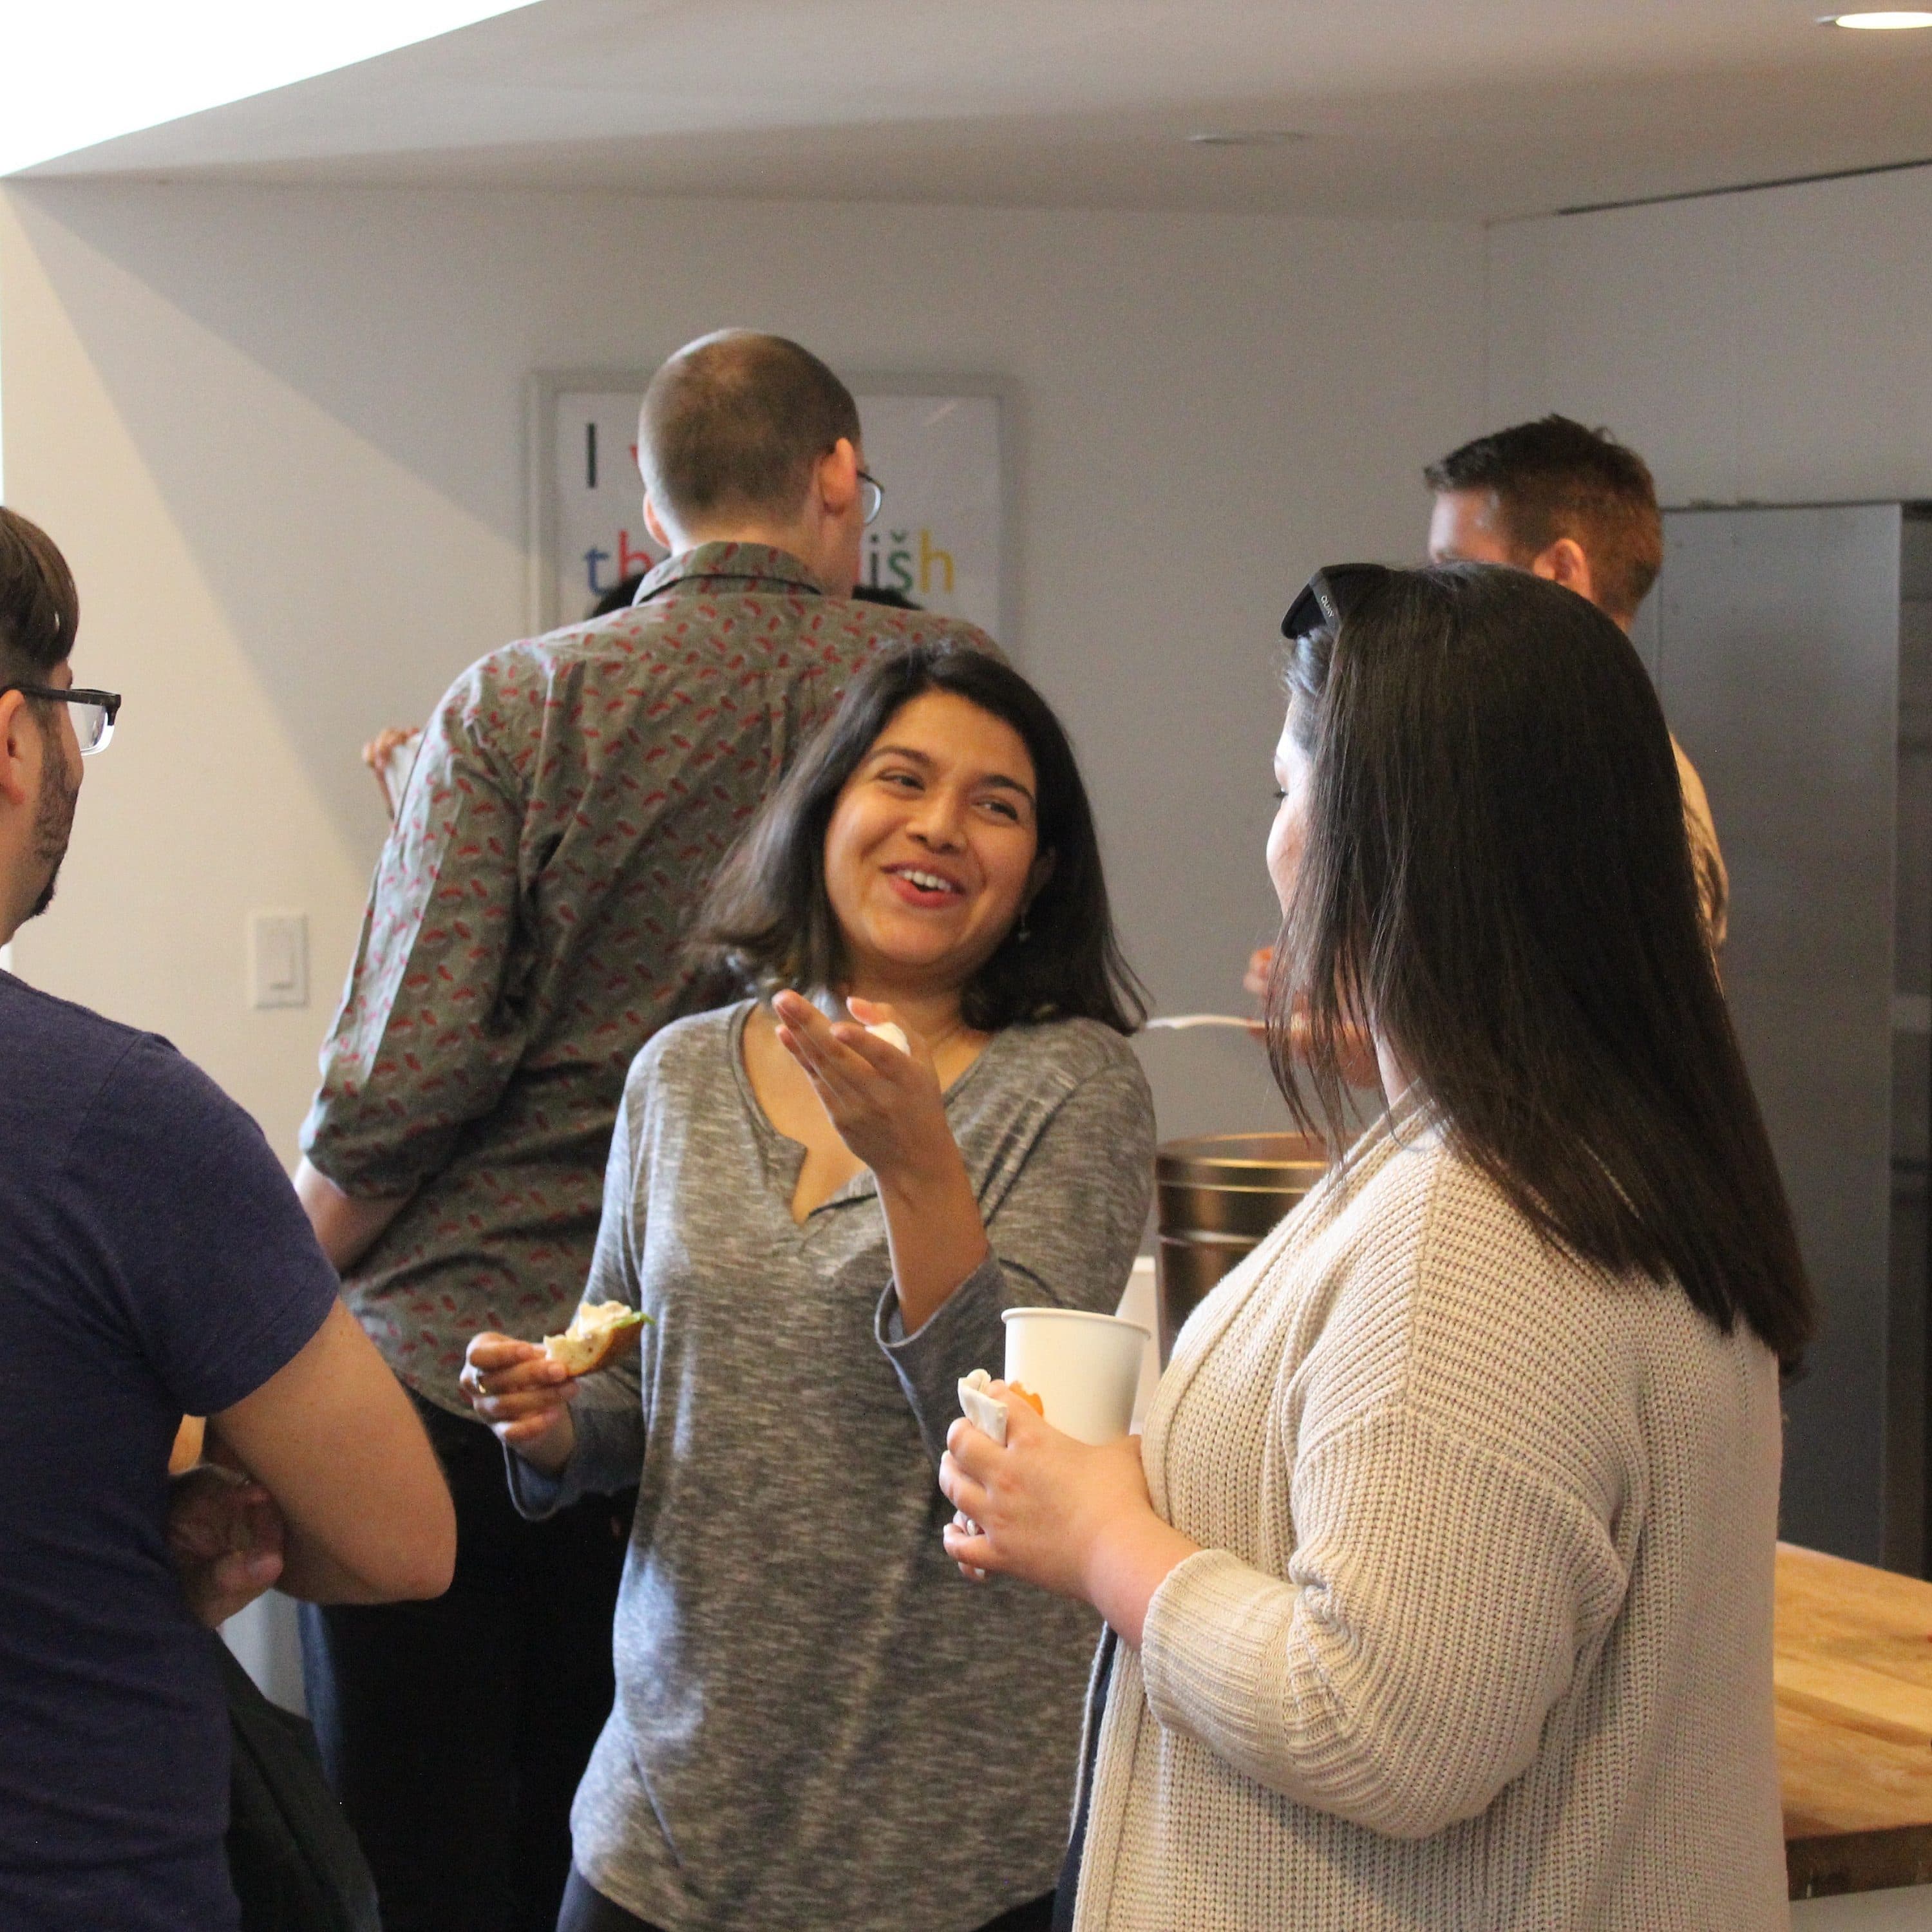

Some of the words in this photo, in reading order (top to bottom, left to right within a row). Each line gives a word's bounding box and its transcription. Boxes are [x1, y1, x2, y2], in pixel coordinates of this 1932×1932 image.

[587, 423, 598, 488] I
[583, 529, 655, 594] th
[870, 529, 954, 593] išh
